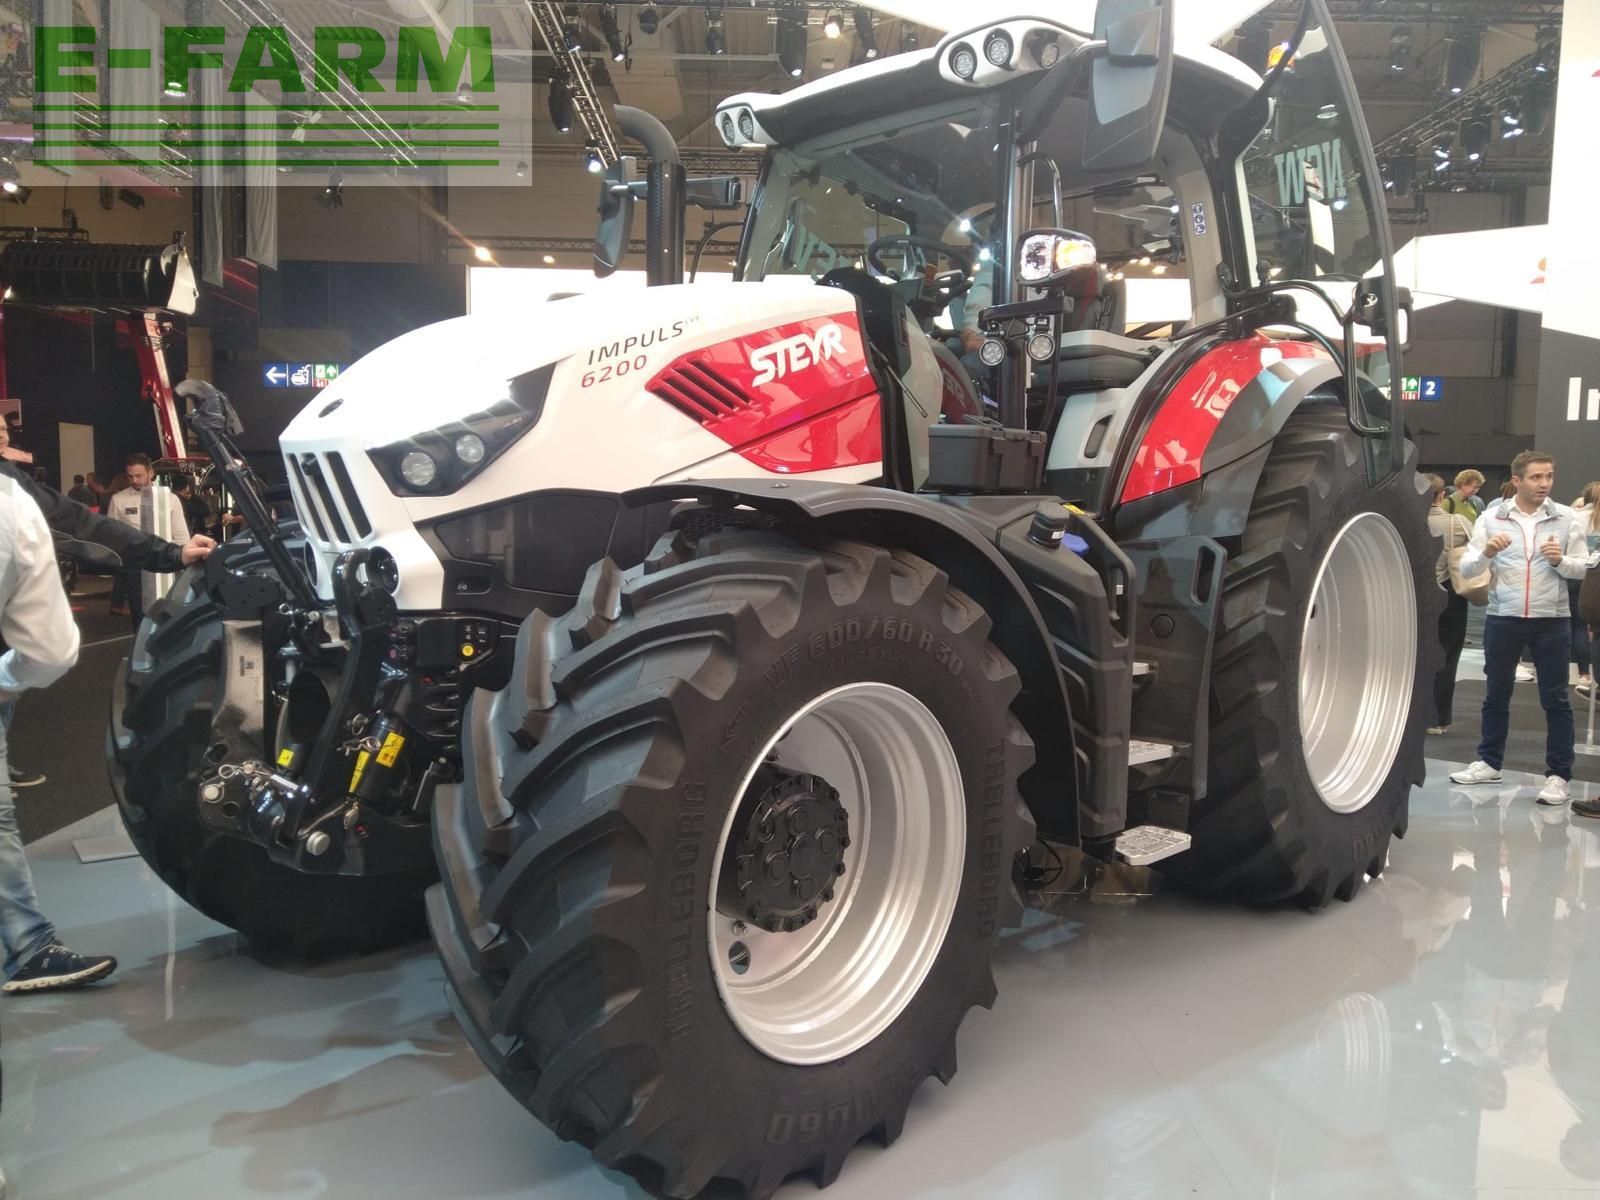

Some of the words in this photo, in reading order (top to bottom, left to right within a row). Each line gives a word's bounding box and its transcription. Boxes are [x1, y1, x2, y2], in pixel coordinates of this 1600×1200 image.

[588, 320, 684, 365] IMPULS
[750, 323, 848, 388] STEYR
[581, 354, 648, 388] 6200
[1425, 380, 1436, 396] 2
[808, 616, 914, 659] 600/60
[918, 629, 935, 653] R
[936, 640, 965, 677] 30
